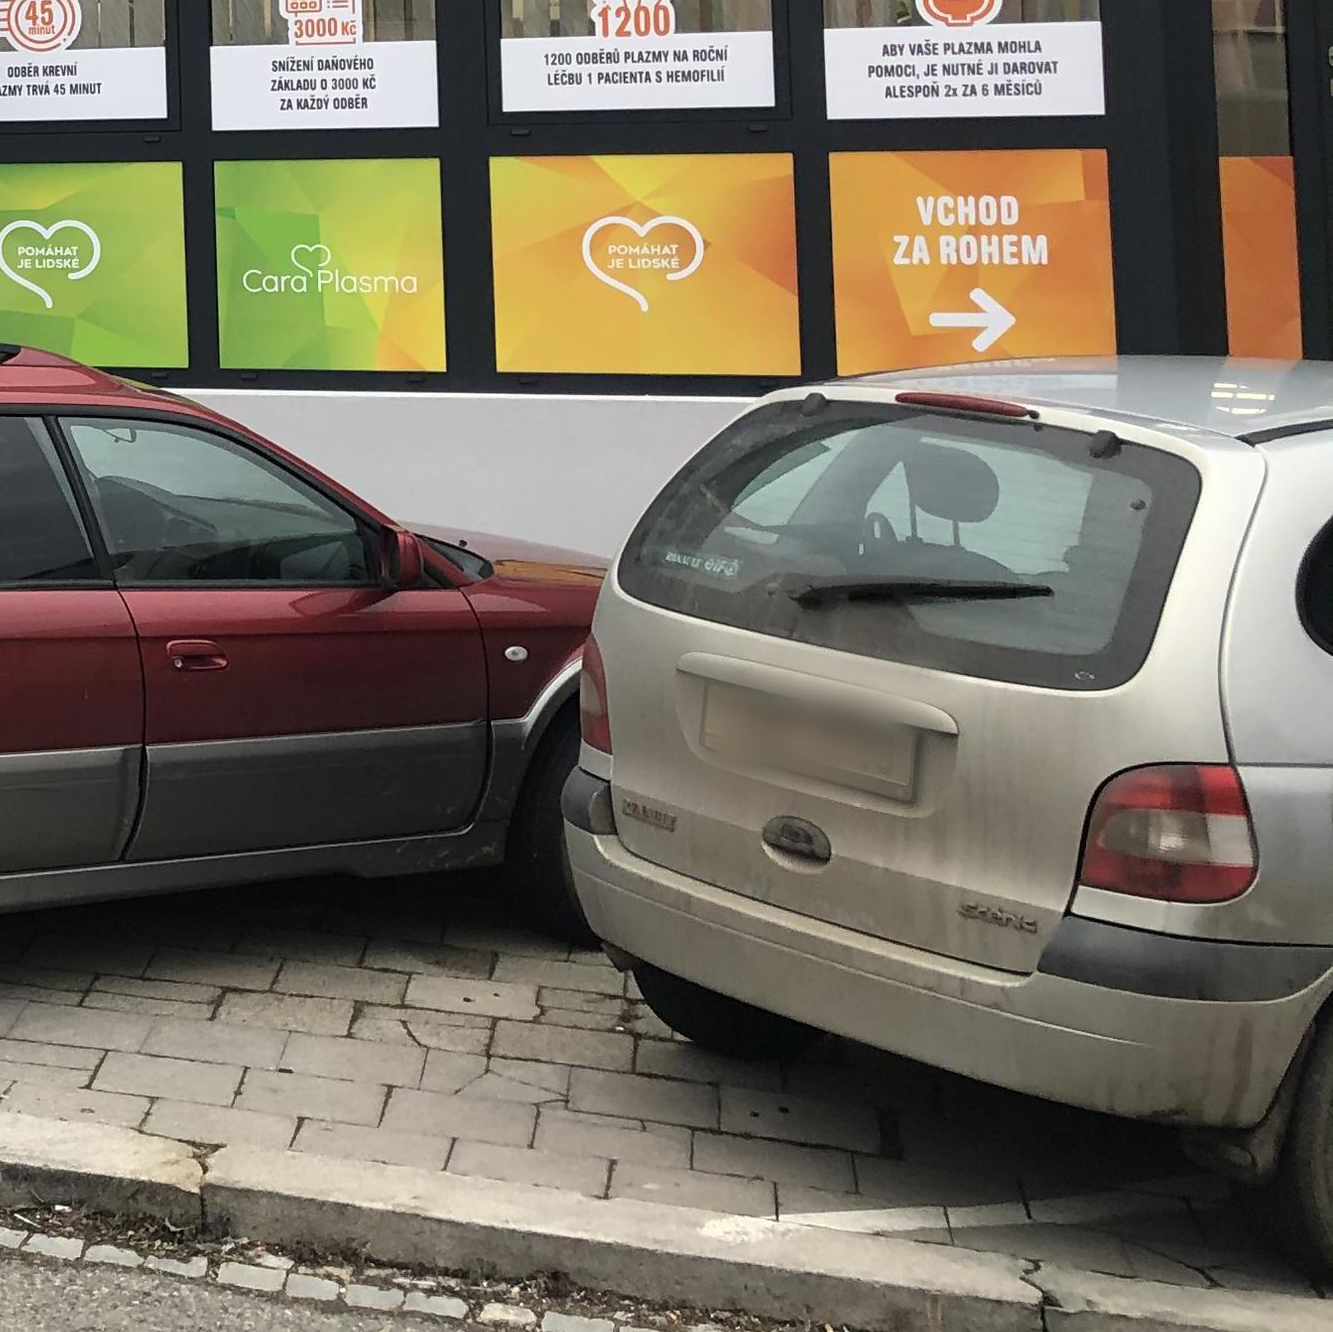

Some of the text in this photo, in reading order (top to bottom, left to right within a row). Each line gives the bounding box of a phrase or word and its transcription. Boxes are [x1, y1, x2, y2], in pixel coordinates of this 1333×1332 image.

[25, 0, 54, 27] 45
[598, 4, 670, 38] 1200
[28, 25, 55, 35] minut
[294, 17, 357, 39] 3000 Kč
[543, 45, 728, 66] 1200 ODBĚRŮ PLAZMY NA ROČNÍ
[882, 39, 1042, 57] ABY VAŠE PLAZMA MOHLA
[7, 61, 77, 78] ODBĚR KREVNÍ
[271, 55, 374, 72] SNÍŽENÍ DAŇOVÉHO
[868, 59, 1058, 80] POMOCI, JE NUTNÉ JI DAROVAT
[270, 74, 377, 92] ZÁKLADU O 3000 KČ
[547, 66, 725, 86] LÉČBU 1 PACIENTA S HEMOFILIÍ
[26, 80, 50, 96] TRVÁ
[53, 83, 66, 95] 45
[69, 83, 102, 95] MINUT
[885, 78, 1042, 98] ALESPOŇ 2x ZA 6 MĚSÍCŮ
[279, 94, 368, 111] ZA KAŽDÝ ODBĚR
[916, 195, 1019, 226] VCHOD
[17, 245, 78, 258] POMÁHAT
[607, 242, 679, 256] POMÁHAT
[893, 235, 1048, 266] ZA ROHEM
[17, 256, 80, 269] JE LIDSKÉ
[607, 255, 680, 269] JE LIDSKÉ
[242, 269, 418, 293] Cara Plasma
